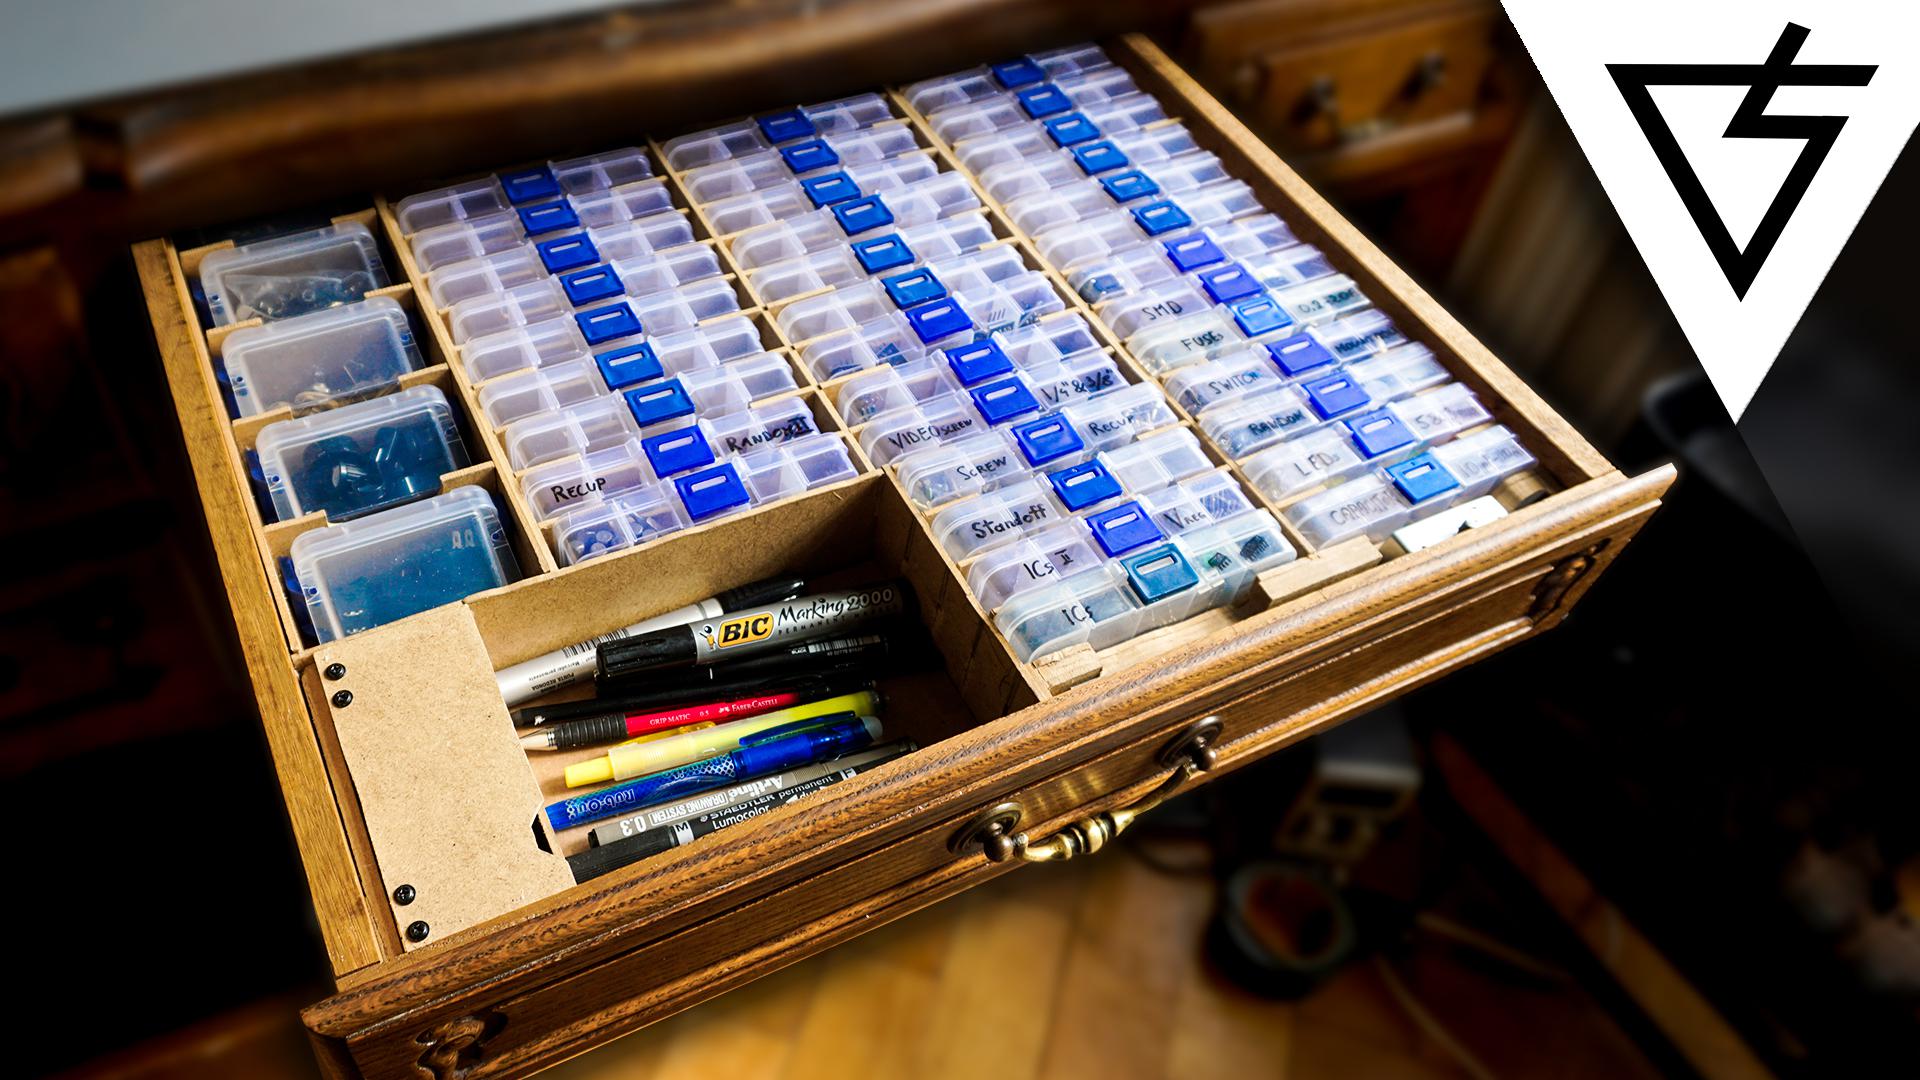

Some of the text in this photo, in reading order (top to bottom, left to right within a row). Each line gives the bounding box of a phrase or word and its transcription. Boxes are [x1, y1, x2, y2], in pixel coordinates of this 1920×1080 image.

[1142, 301, 1183, 320] SMD
[956, 456, 1007, 481] SCREW
[550, 477, 606, 503] RECUP
[972, 503, 1047, 539] Standoff
[1023, 560, 1054, 580] ICs
[778, 588, 893, 626] Marking 2000
[722, 616, 770, 643] BIC
[778, 615, 846, 635] PERMANENT
[779, 776, 835, 800] permanent
[619, 775, 783, 837] Artline DRAWING SYSTEM 0.3
[712, 803, 771, 831] Lumocolor
[674, 821, 689, 832] M
